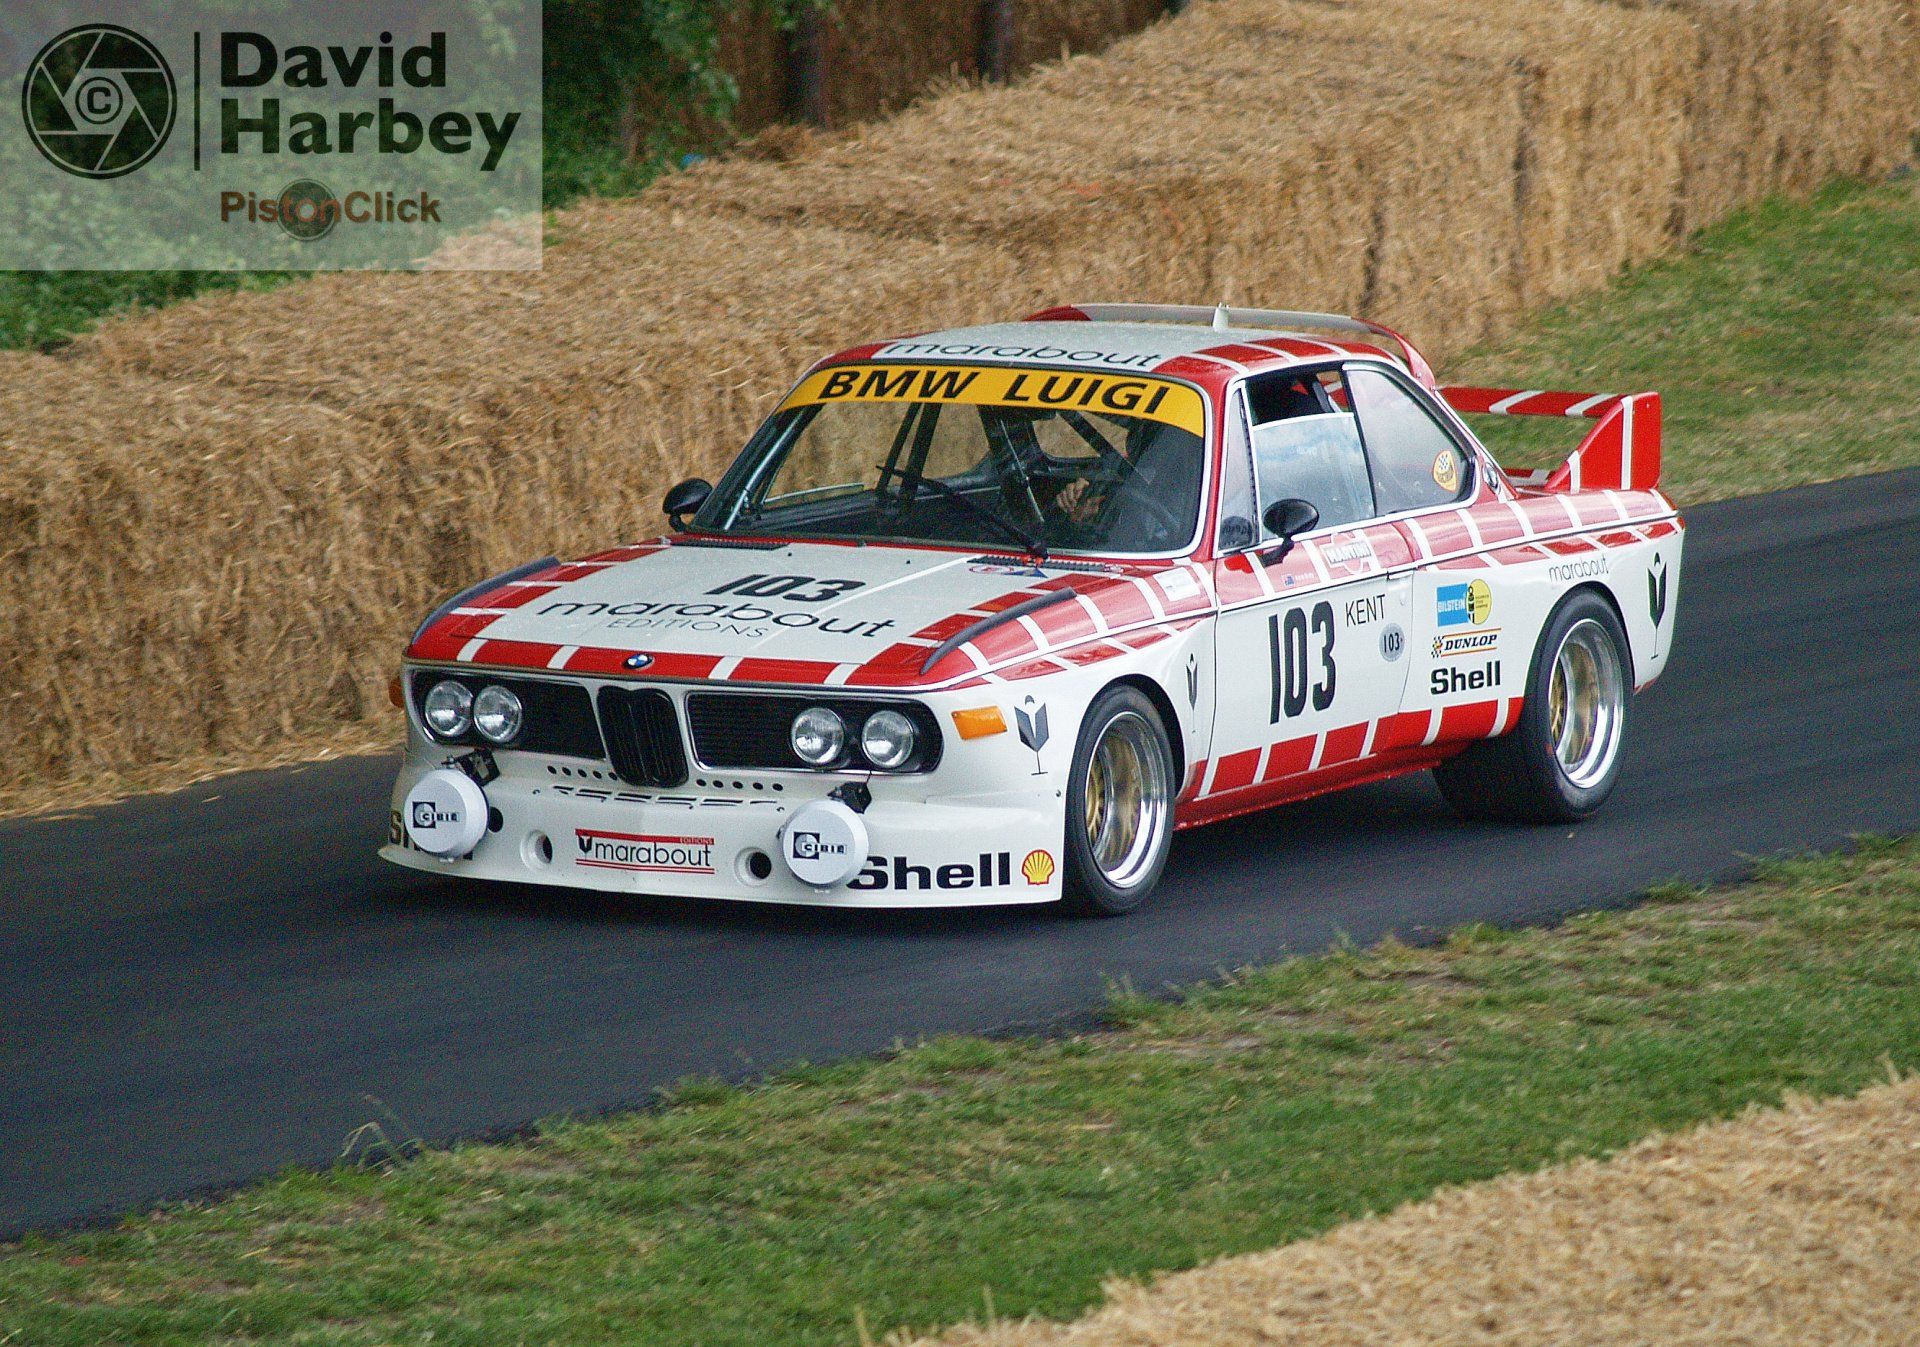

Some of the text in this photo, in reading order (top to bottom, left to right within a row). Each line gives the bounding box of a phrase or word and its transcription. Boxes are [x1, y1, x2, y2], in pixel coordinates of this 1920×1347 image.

[885, 342, 1163, 368] marabout
[818, 369, 1171, 414] BMW LUIGI
[1548, 553, 1609, 582] marabout
[703, 573, 867, 602] 103
[536, 602, 896, 638] marabout
[1345, 594, 1386, 628] KENT
[1437, 598, 1466, 613] BILSTEIN
[606, 618, 769, 638] EDITIONS
[1383, 632, 1401, 653] 103
[1444, 634, 1498, 652] DUNLOP
[1268, 600, 1337, 725] 103
[1430, 660, 1501, 696] Shell
[594, 841, 712, 867] marabout
[846, 851, 1011, 890] Shell
